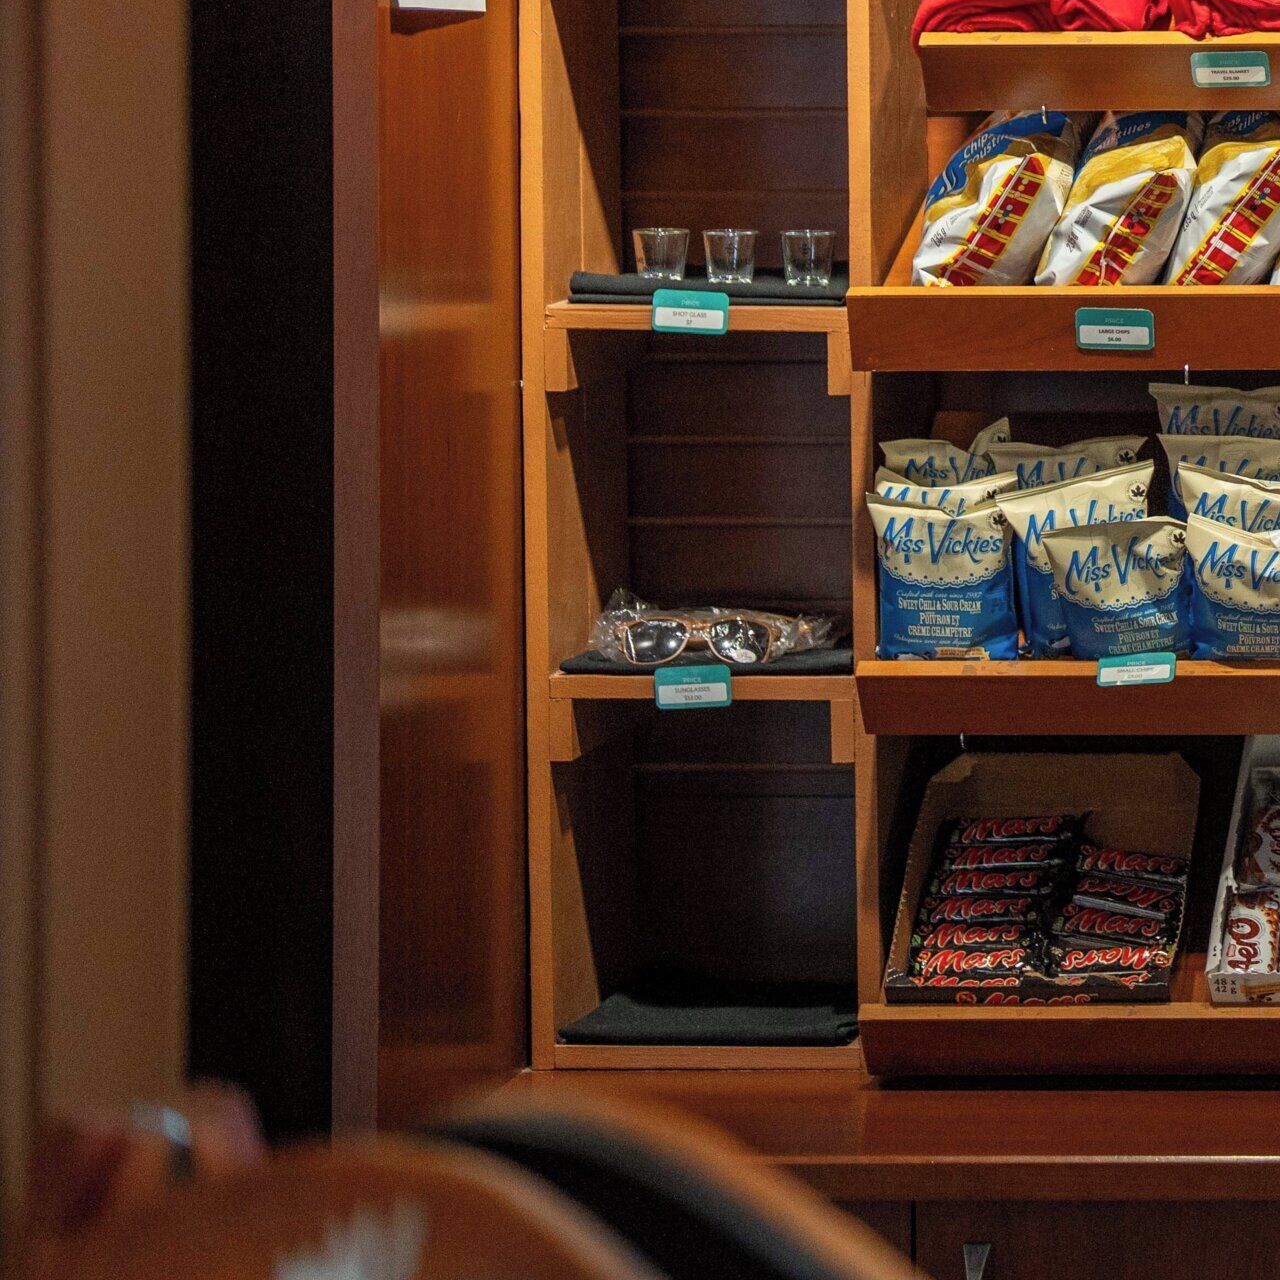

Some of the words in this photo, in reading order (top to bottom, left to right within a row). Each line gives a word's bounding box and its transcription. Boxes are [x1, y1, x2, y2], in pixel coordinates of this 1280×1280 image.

[882, 517, 923, 564] Miss
[928, 520, 1003, 567] Vickie's
[1198, 542, 1245, 589] Miss
[925, 923, 1025, 948] Mars
[923, 948, 1025, 976] Mars
[1214, 978, 1227, 986] 48
